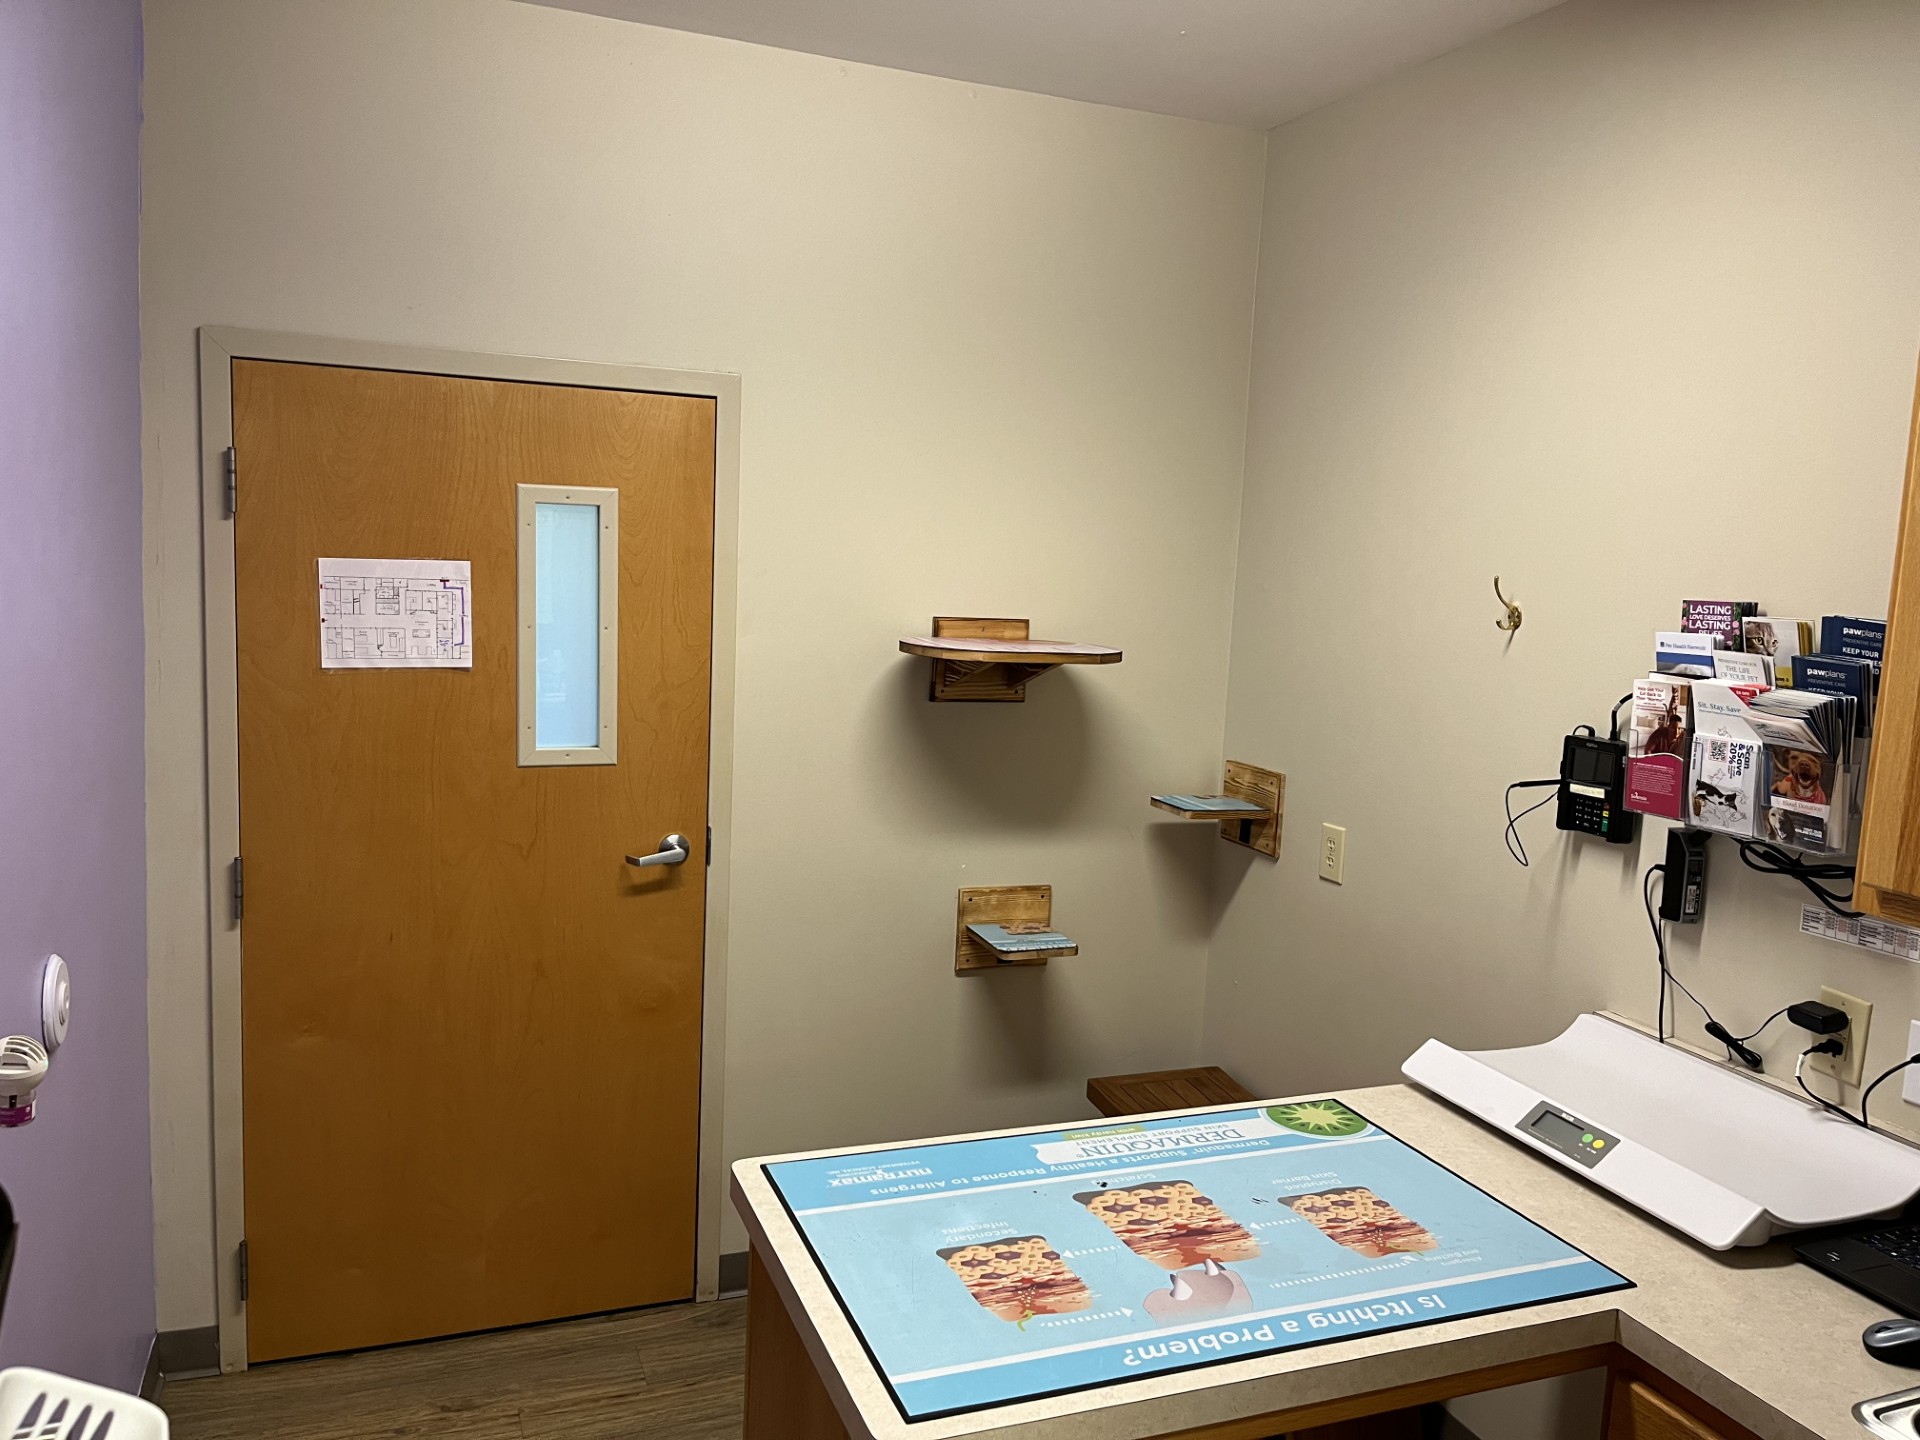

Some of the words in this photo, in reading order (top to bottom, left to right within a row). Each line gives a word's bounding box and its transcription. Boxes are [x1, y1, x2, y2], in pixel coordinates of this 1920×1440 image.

[1689, 604, 1731, 615] LASTING
[1688, 620, 1731, 630] LASTING
[1843, 647, 1860, 655] KEEP
[1861, 649, 1879, 658] YOUR
[1726, 665, 1736, 673] THE
[1729, 672, 1746, 680] YOUR
[1697, 701, 1708, 709] Sit.
[1709, 703, 1726, 712] Stay.
[1728, 742, 1738, 765] 20%
[1738, 743, 1745, 751] &
[1743, 744, 1754, 769] Scan
[1735, 752, 1745, 776] Save
[1152, 1126, 1201, 1137] SUPPORT
[1076, 1134, 1147, 1146] SUPPLEMENT
[1121, 1149, 1187, 1163] Supports
[1050, 1160, 1108, 1172] Healthy
[972, 1167, 1047, 1182] Response
[1271, 1175, 1311, 1184] Barrier
[1311, 1171, 1338, 1179] Skin
[869, 1180, 946, 1195] Allergens
[1284, 1178, 1342, 1191] Disrupted
[941, 1221, 1009, 1235] Infections
[945, 1227, 1018, 1243] Secondary
[1417, 1294, 1447, 1309] Is
[1307, 1300, 1415, 1329] Itching
[1280, 1320, 1301, 1333] a
[1123, 1324, 1276, 1366] Problem?
